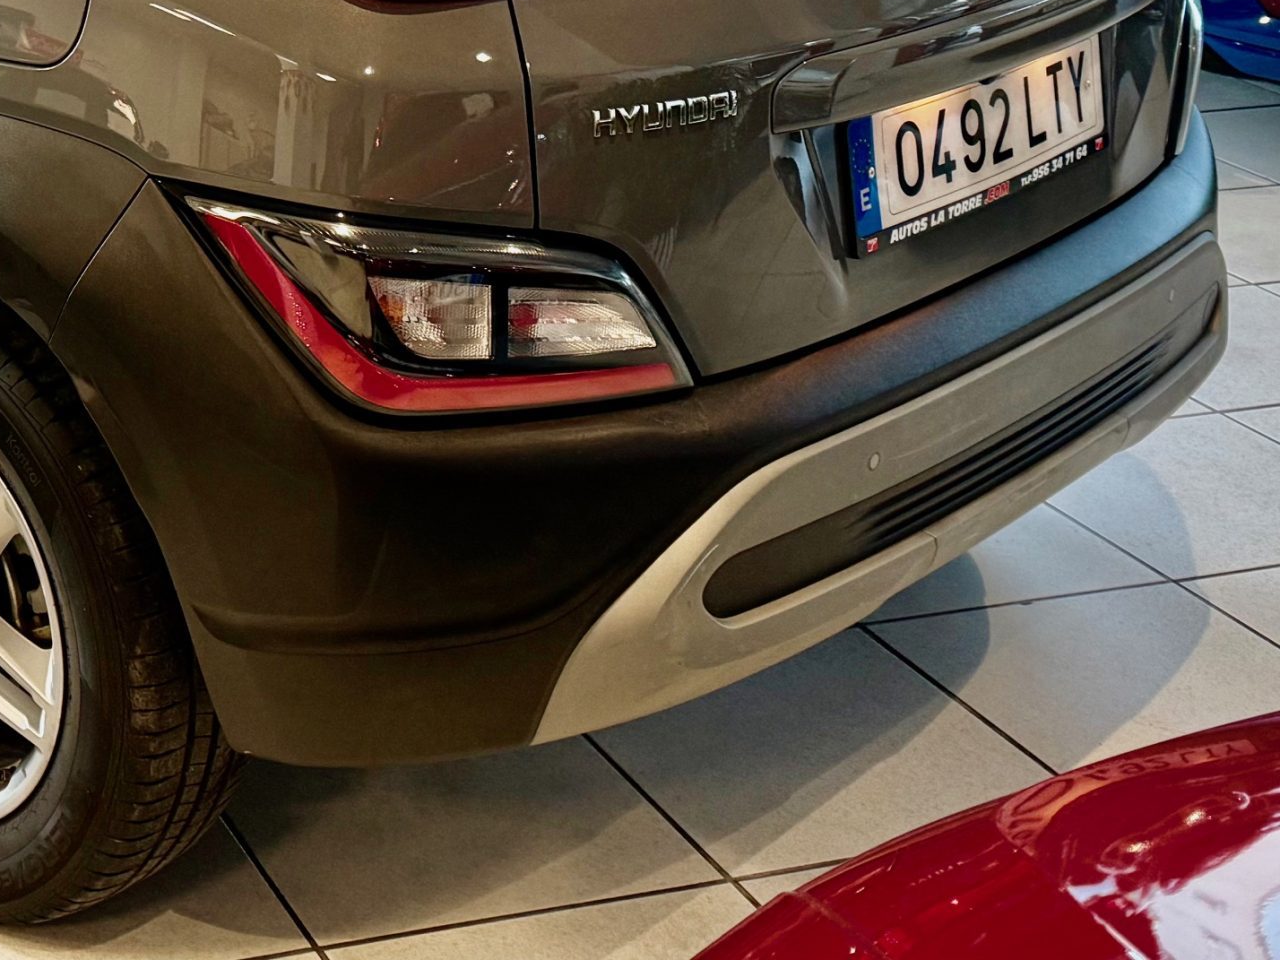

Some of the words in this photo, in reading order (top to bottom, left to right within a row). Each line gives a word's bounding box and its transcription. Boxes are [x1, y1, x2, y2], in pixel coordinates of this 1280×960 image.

[591, 90, 738, 138] HYUNDAI
[895, 87, 1015, 198] 0492
[1023, 50, 1086, 149] LTY
[1051, 156, 1063, 172] 34
[1065, 150, 1075, 166] 71
[1075, 143, 1088, 160] 64
[859, 186, 872, 212] E
[889, 216, 929, 245] AUTOS
[930, 209, 945, 228] LA
[948, 193, 983, 220] TORRE
